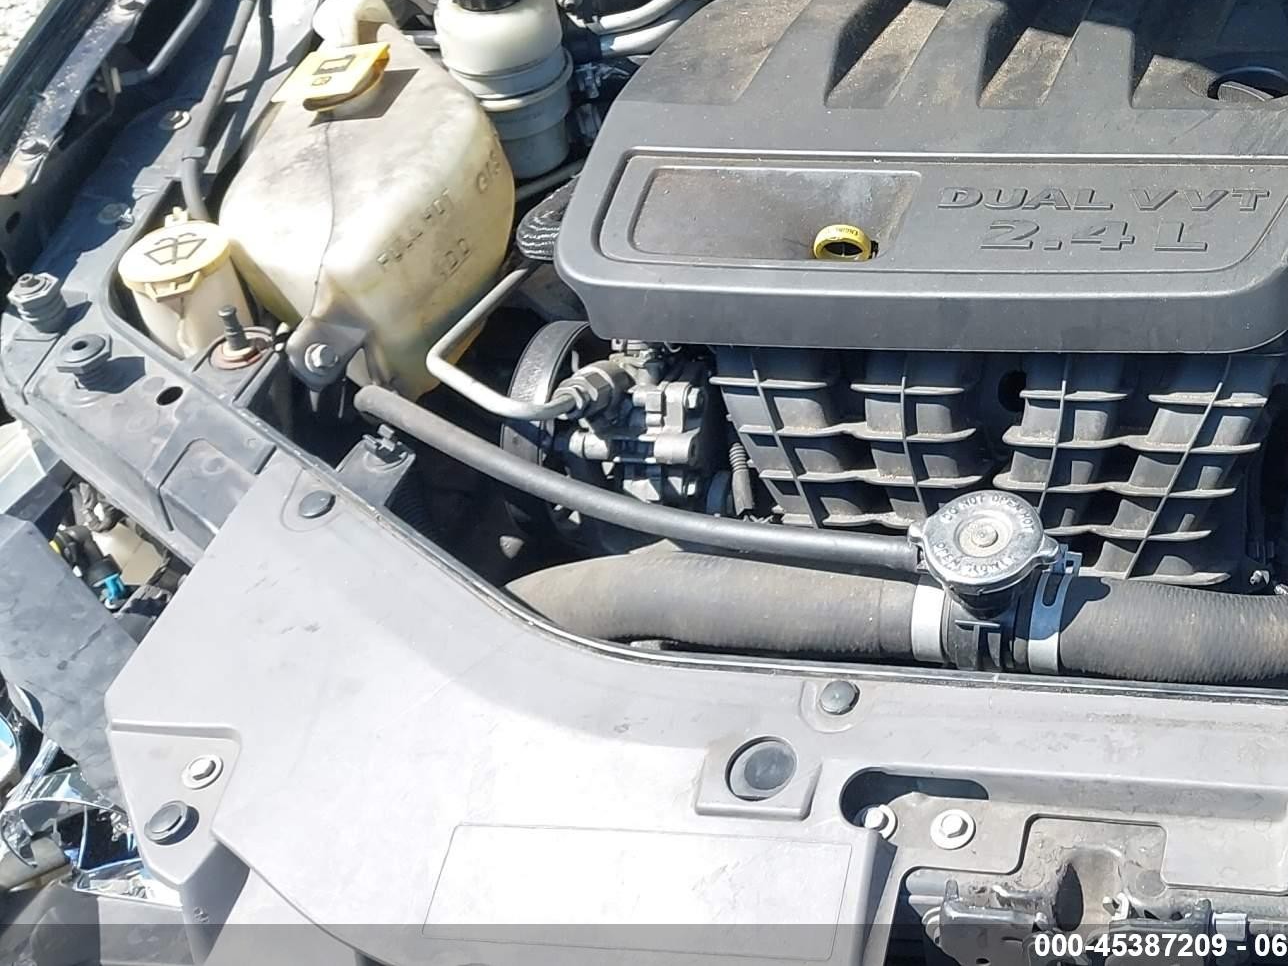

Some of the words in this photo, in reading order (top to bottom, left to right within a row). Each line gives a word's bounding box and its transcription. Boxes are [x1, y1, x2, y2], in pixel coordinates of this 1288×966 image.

[937, 187, 1114, 211] DUAL
[1129, 187, 1270, 212] VVT
[959, 493, 985, 509] NOT
[991, 493, 1023, 513] OPEN
[1019, 510, 1036, 533] HOT
